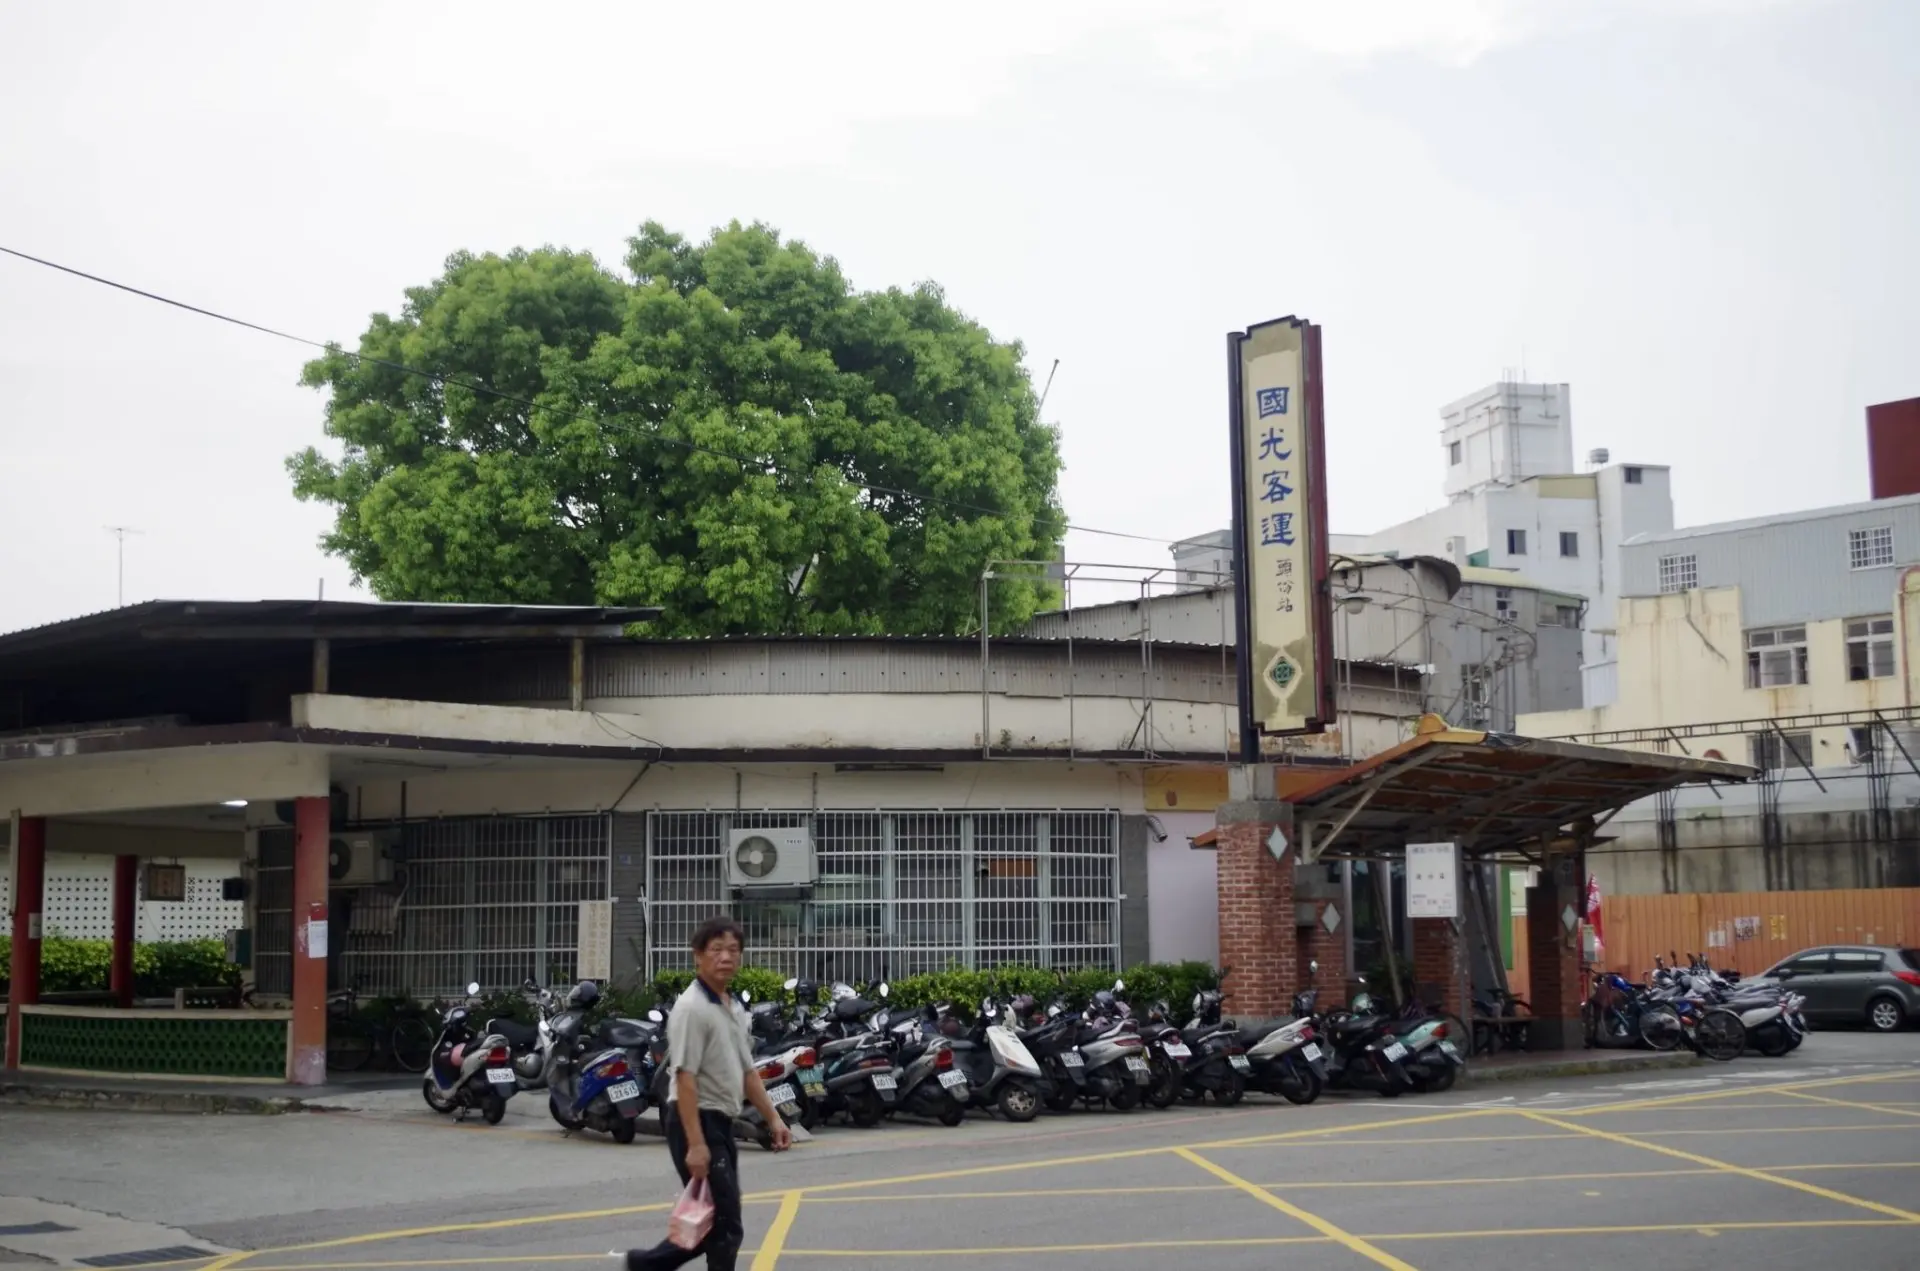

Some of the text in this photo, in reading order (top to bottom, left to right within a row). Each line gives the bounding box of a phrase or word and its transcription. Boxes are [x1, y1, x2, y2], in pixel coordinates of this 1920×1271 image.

[1256, 387, 1296, 546] 國光客運
[1275, 558, 1295, 613] 頭份站
